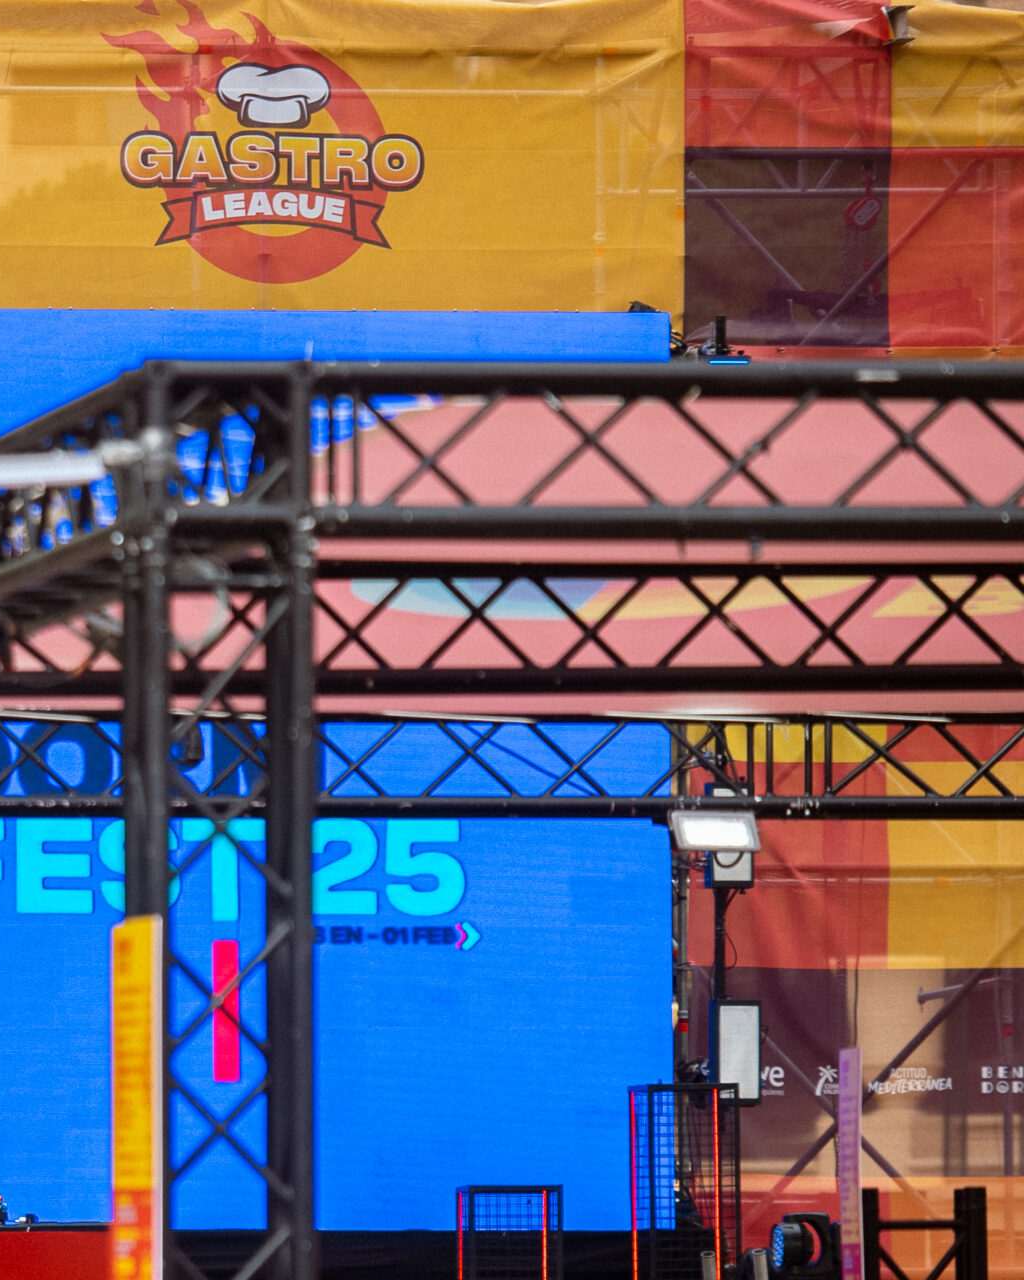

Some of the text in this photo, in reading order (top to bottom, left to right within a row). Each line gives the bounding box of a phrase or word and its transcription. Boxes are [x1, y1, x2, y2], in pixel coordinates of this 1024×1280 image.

[122, 132, 423, 190] GASTRO
[201, 191, 345, 223] LEAGUE
[312, 819, 466, 916] 25
[330, 926, 363, 945] EN
[382, 926, 408, 945] 01
[412, 926, 458, 945] FEB
[868, 1076, 953, 1095] MEDITERRÁNEA
[891, 1068, 927, 1079] ACTITUD
